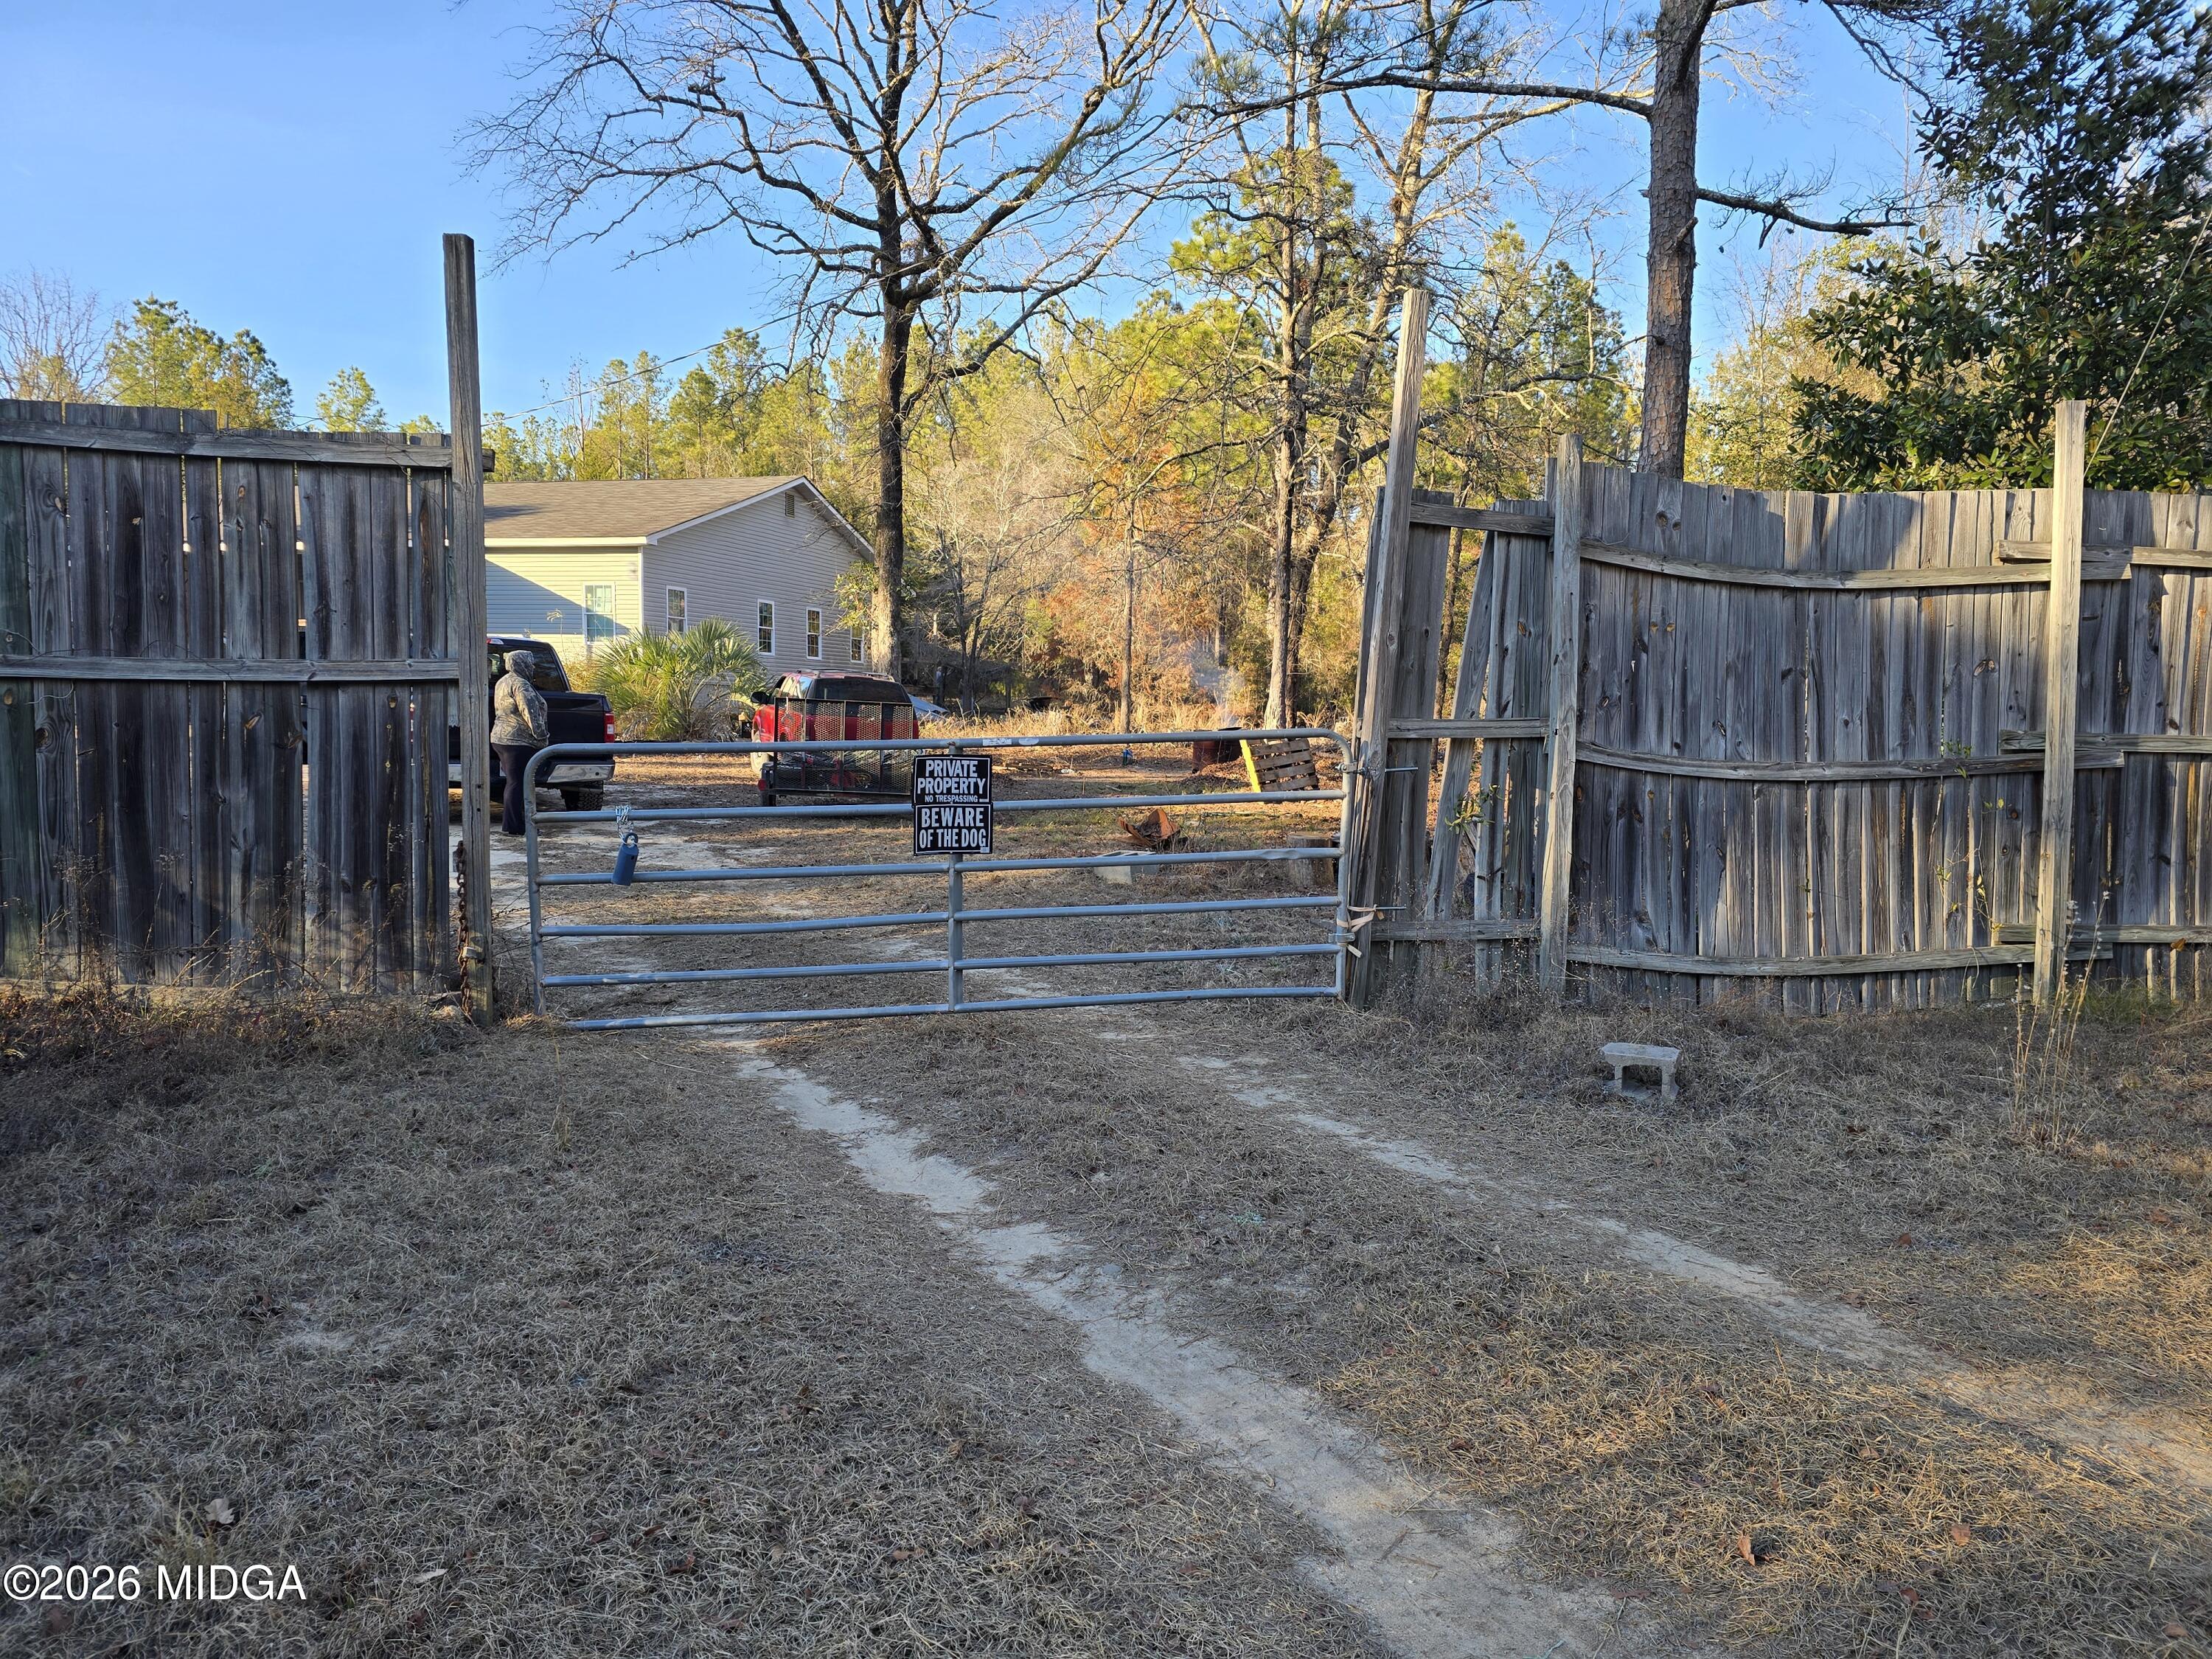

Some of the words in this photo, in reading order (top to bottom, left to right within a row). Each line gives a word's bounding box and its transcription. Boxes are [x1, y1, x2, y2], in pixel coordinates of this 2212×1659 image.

[925, 760, 978, 777] PRIVATE
[917, 778, 986, 794] PROPERTY
[921, 807, 984, 827] BEWARE
[919, 829, 933, 849] OF
[936, 829, 959, 847] THE
[961, 829, 987, 847] DOG
